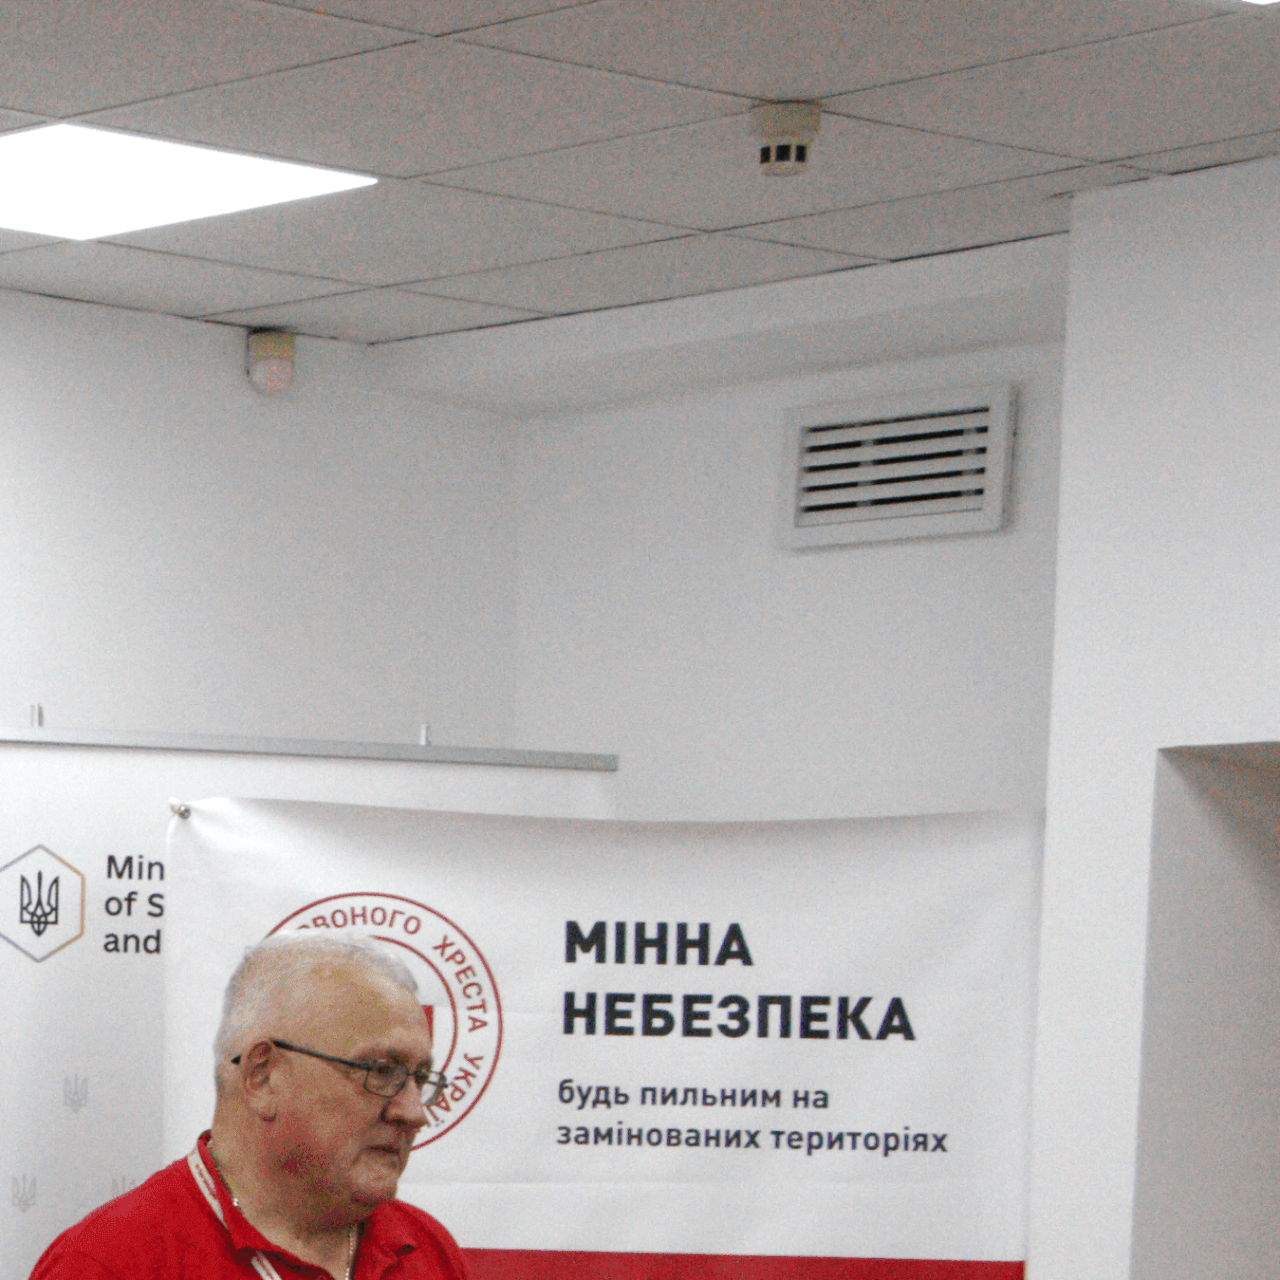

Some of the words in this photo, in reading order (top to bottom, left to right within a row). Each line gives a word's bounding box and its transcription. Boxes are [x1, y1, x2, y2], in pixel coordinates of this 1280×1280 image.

[106, 854, 165, 880] Min
[104, 891, 138, 917] of
[147, 893, 164, 918] S
[297, 906, 421, 935] ВОНОГО
[103, 929, 161, 954] and
[564, 920, 754, 966] МІННА
[433, 935, 488, 1033] ХРЕСТА
[562, 991, 917, 1041] НЕБЕЗПЕКА
[425, 1052, 484, 1127] УКРАЇ
[557, 1079, 629, 1110] будь
[640, 1084, 781, 1108] пильним
[792, 1087, 829, 1109] на
[556, 1121, 760, 1149] замінованих
[770, 1126, 949, 1157] територіях
